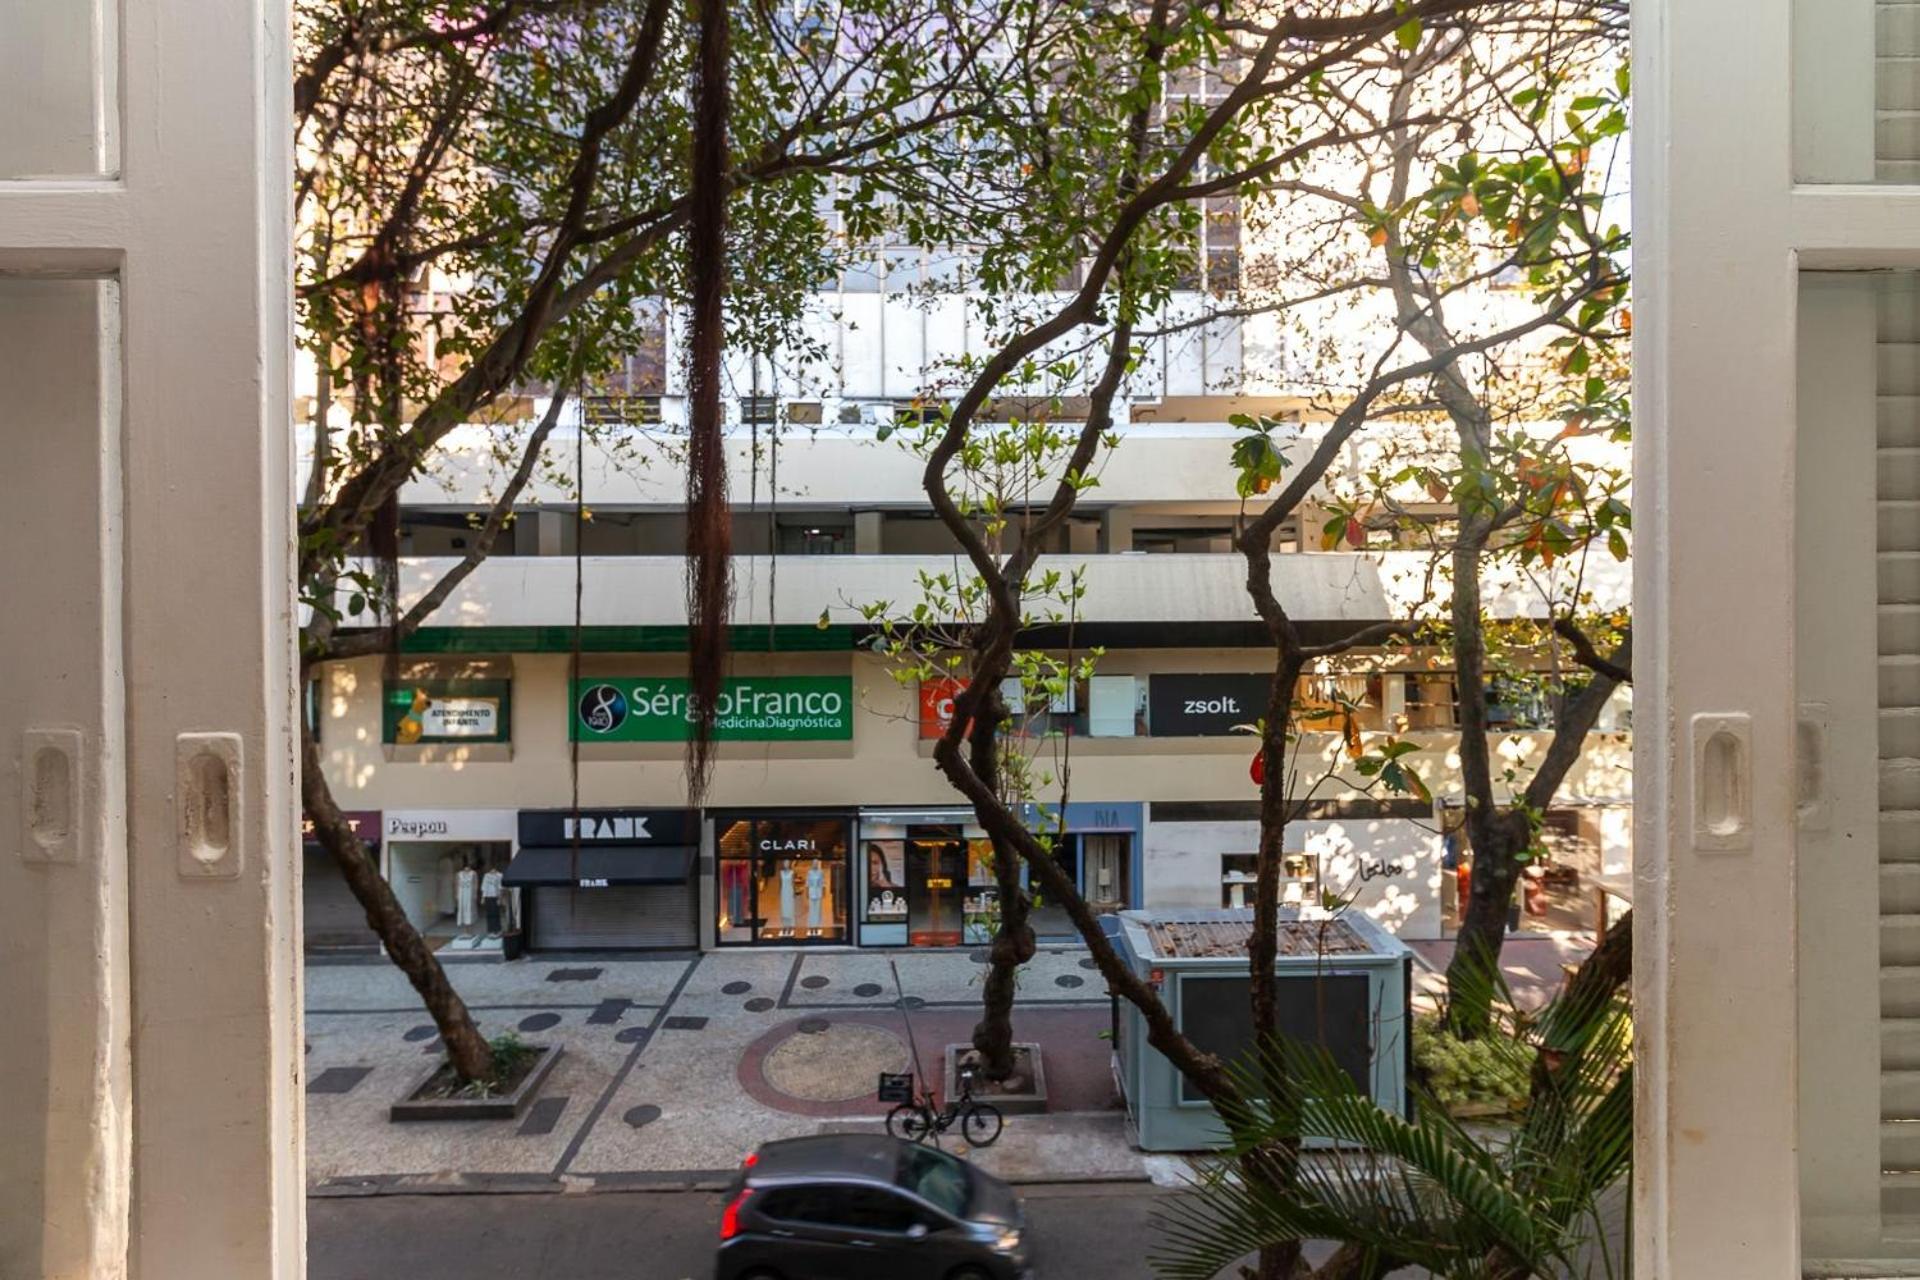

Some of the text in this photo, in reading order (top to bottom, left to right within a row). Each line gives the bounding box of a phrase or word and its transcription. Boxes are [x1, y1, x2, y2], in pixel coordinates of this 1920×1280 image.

[632, 685, 842, 722] SérgoFranco
[1184, 696, 1240, 713] zsolt.
[563, 817, 653, 839] FRANK
[760, 839, 816, 851] CLARI
[580, 878, 609, 888] FRANK
